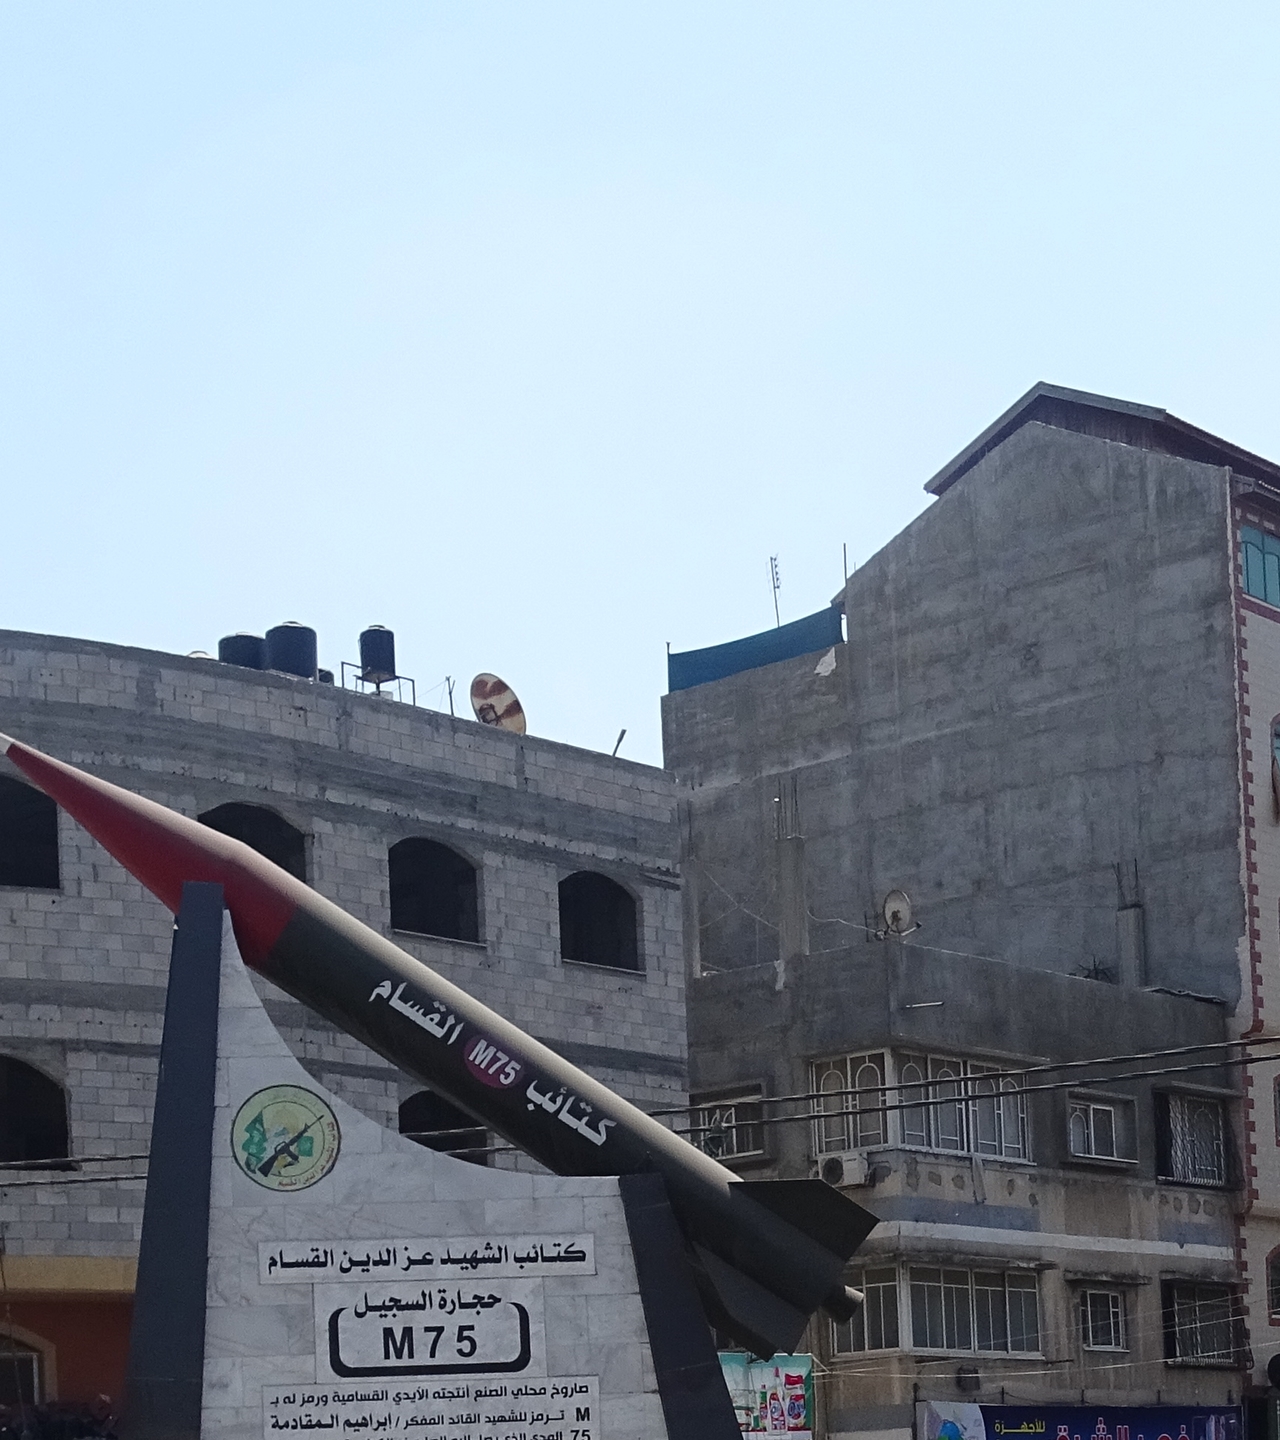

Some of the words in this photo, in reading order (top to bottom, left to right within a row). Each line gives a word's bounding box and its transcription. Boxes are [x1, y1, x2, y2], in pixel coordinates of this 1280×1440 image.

[368, 979, 464, 1045] القسام
[468, 1038, 520, 1086] M75
[525, 1079, 617, 1147] كتائب
[267, 1248, 335, 1275] القسام
[338, 1247, 398, 1275] الدين
[400, 1246, 435, 1274] عز
[439, 1241, 509, 1271] الشهيد
[513, 1241, 587, 1270] كتائب
[353, 1290, 434, 1318] السجيل
[437, 1286, 503, 1313] حجارة
[282, 1393, 296, 1405] له
[332, 1389, 388, 1406] القسامية
[392, 1385, 429, 1405] الأيدي
[432, 1384, 470, 1402] أنتجته
[473, 1385, 507, 1402] الصنع
[511, 1384, 547, 1399] محلي
[550, 1382, 589, 1399] صاروخ
[299, 1393, 329, 1407] ورمز
[270, 1413, 339, 1430] المقادمة
[403, 1414, 444, 1430] المفكر
[448, 1413, 481, 1425] القائد
[484, 1409, 527, 1426] للشهيد
[575, 1406, 591, 1422] M
[994, 1418, 1046, 1436] للأجهزة
